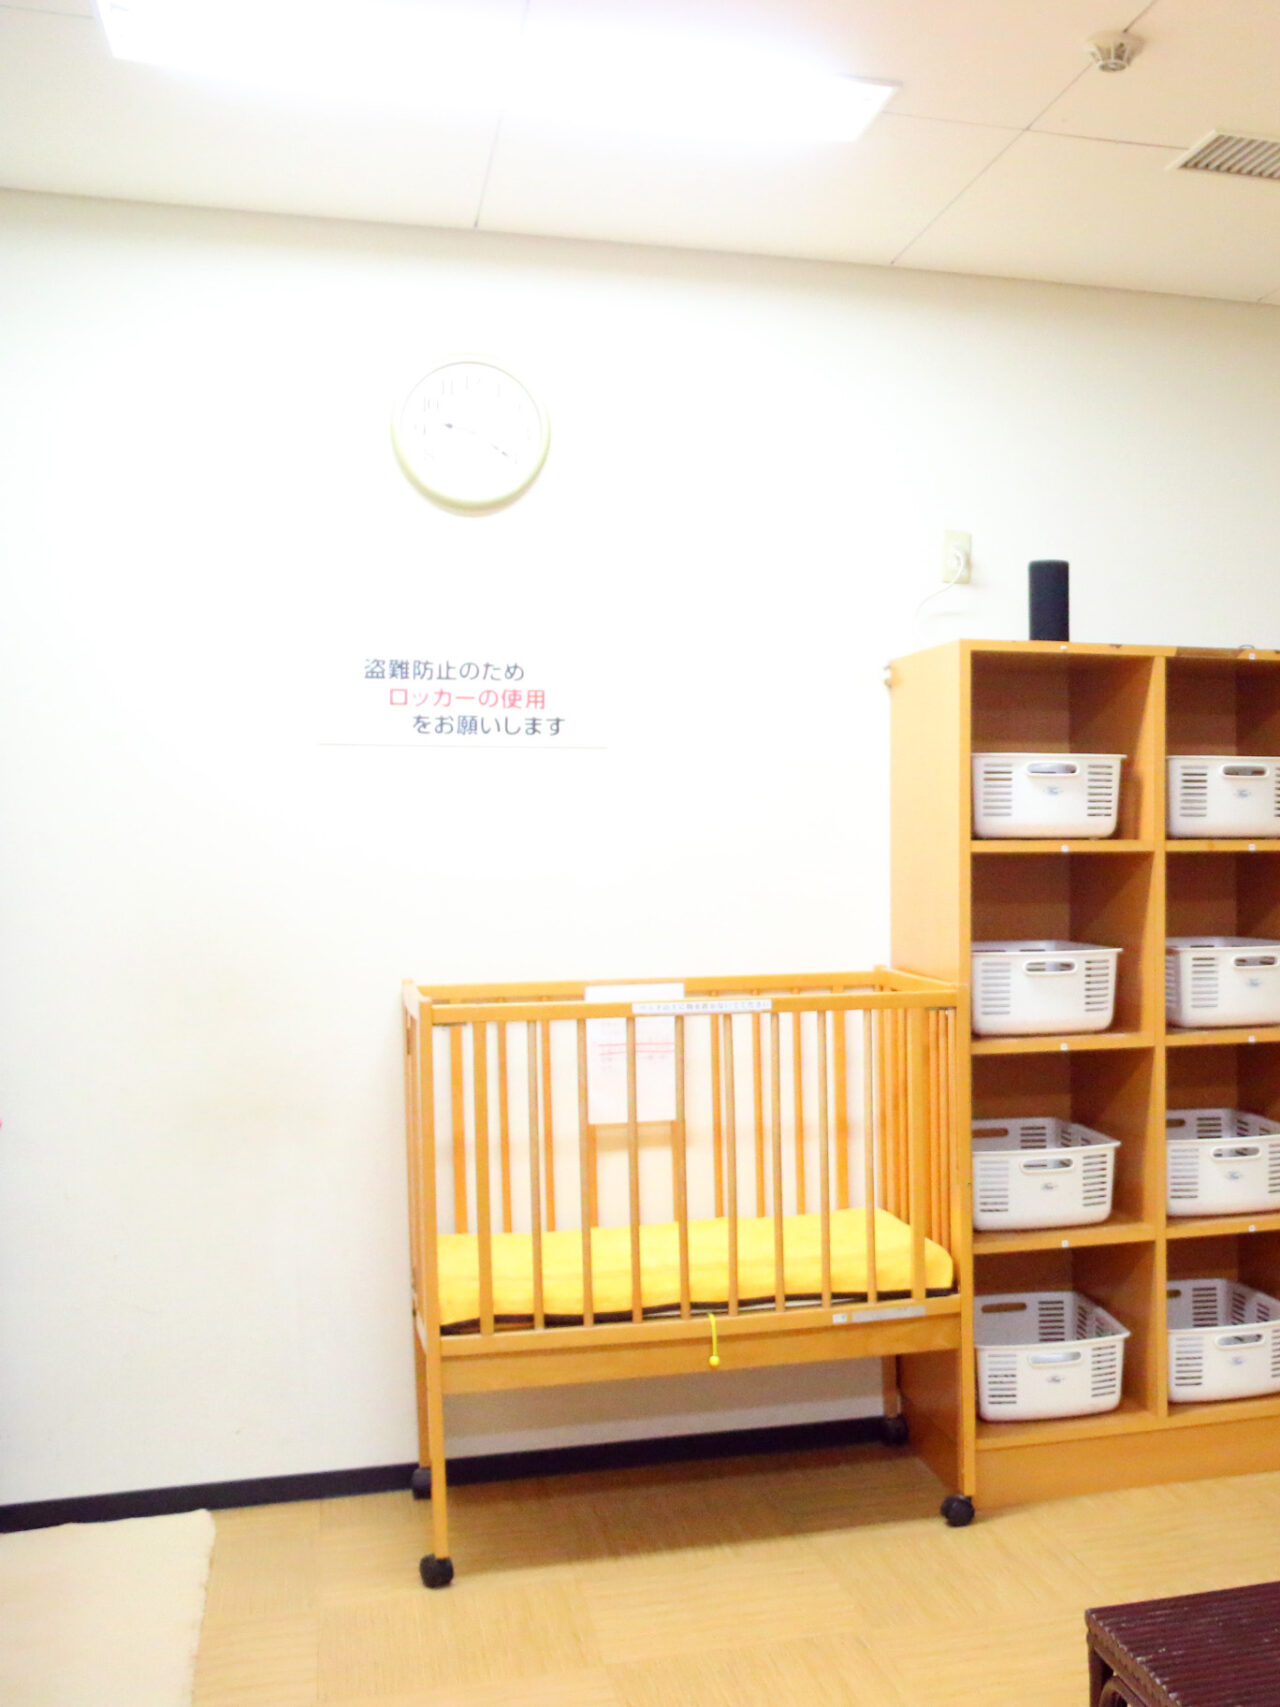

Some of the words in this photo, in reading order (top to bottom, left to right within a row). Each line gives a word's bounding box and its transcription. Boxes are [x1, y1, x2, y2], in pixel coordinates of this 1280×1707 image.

[363, 658, 526, 682] 盗難防止のため
[388, 688, 547, 710] ロッカーの使用
[411, 714, 567, 737] をお願いします
